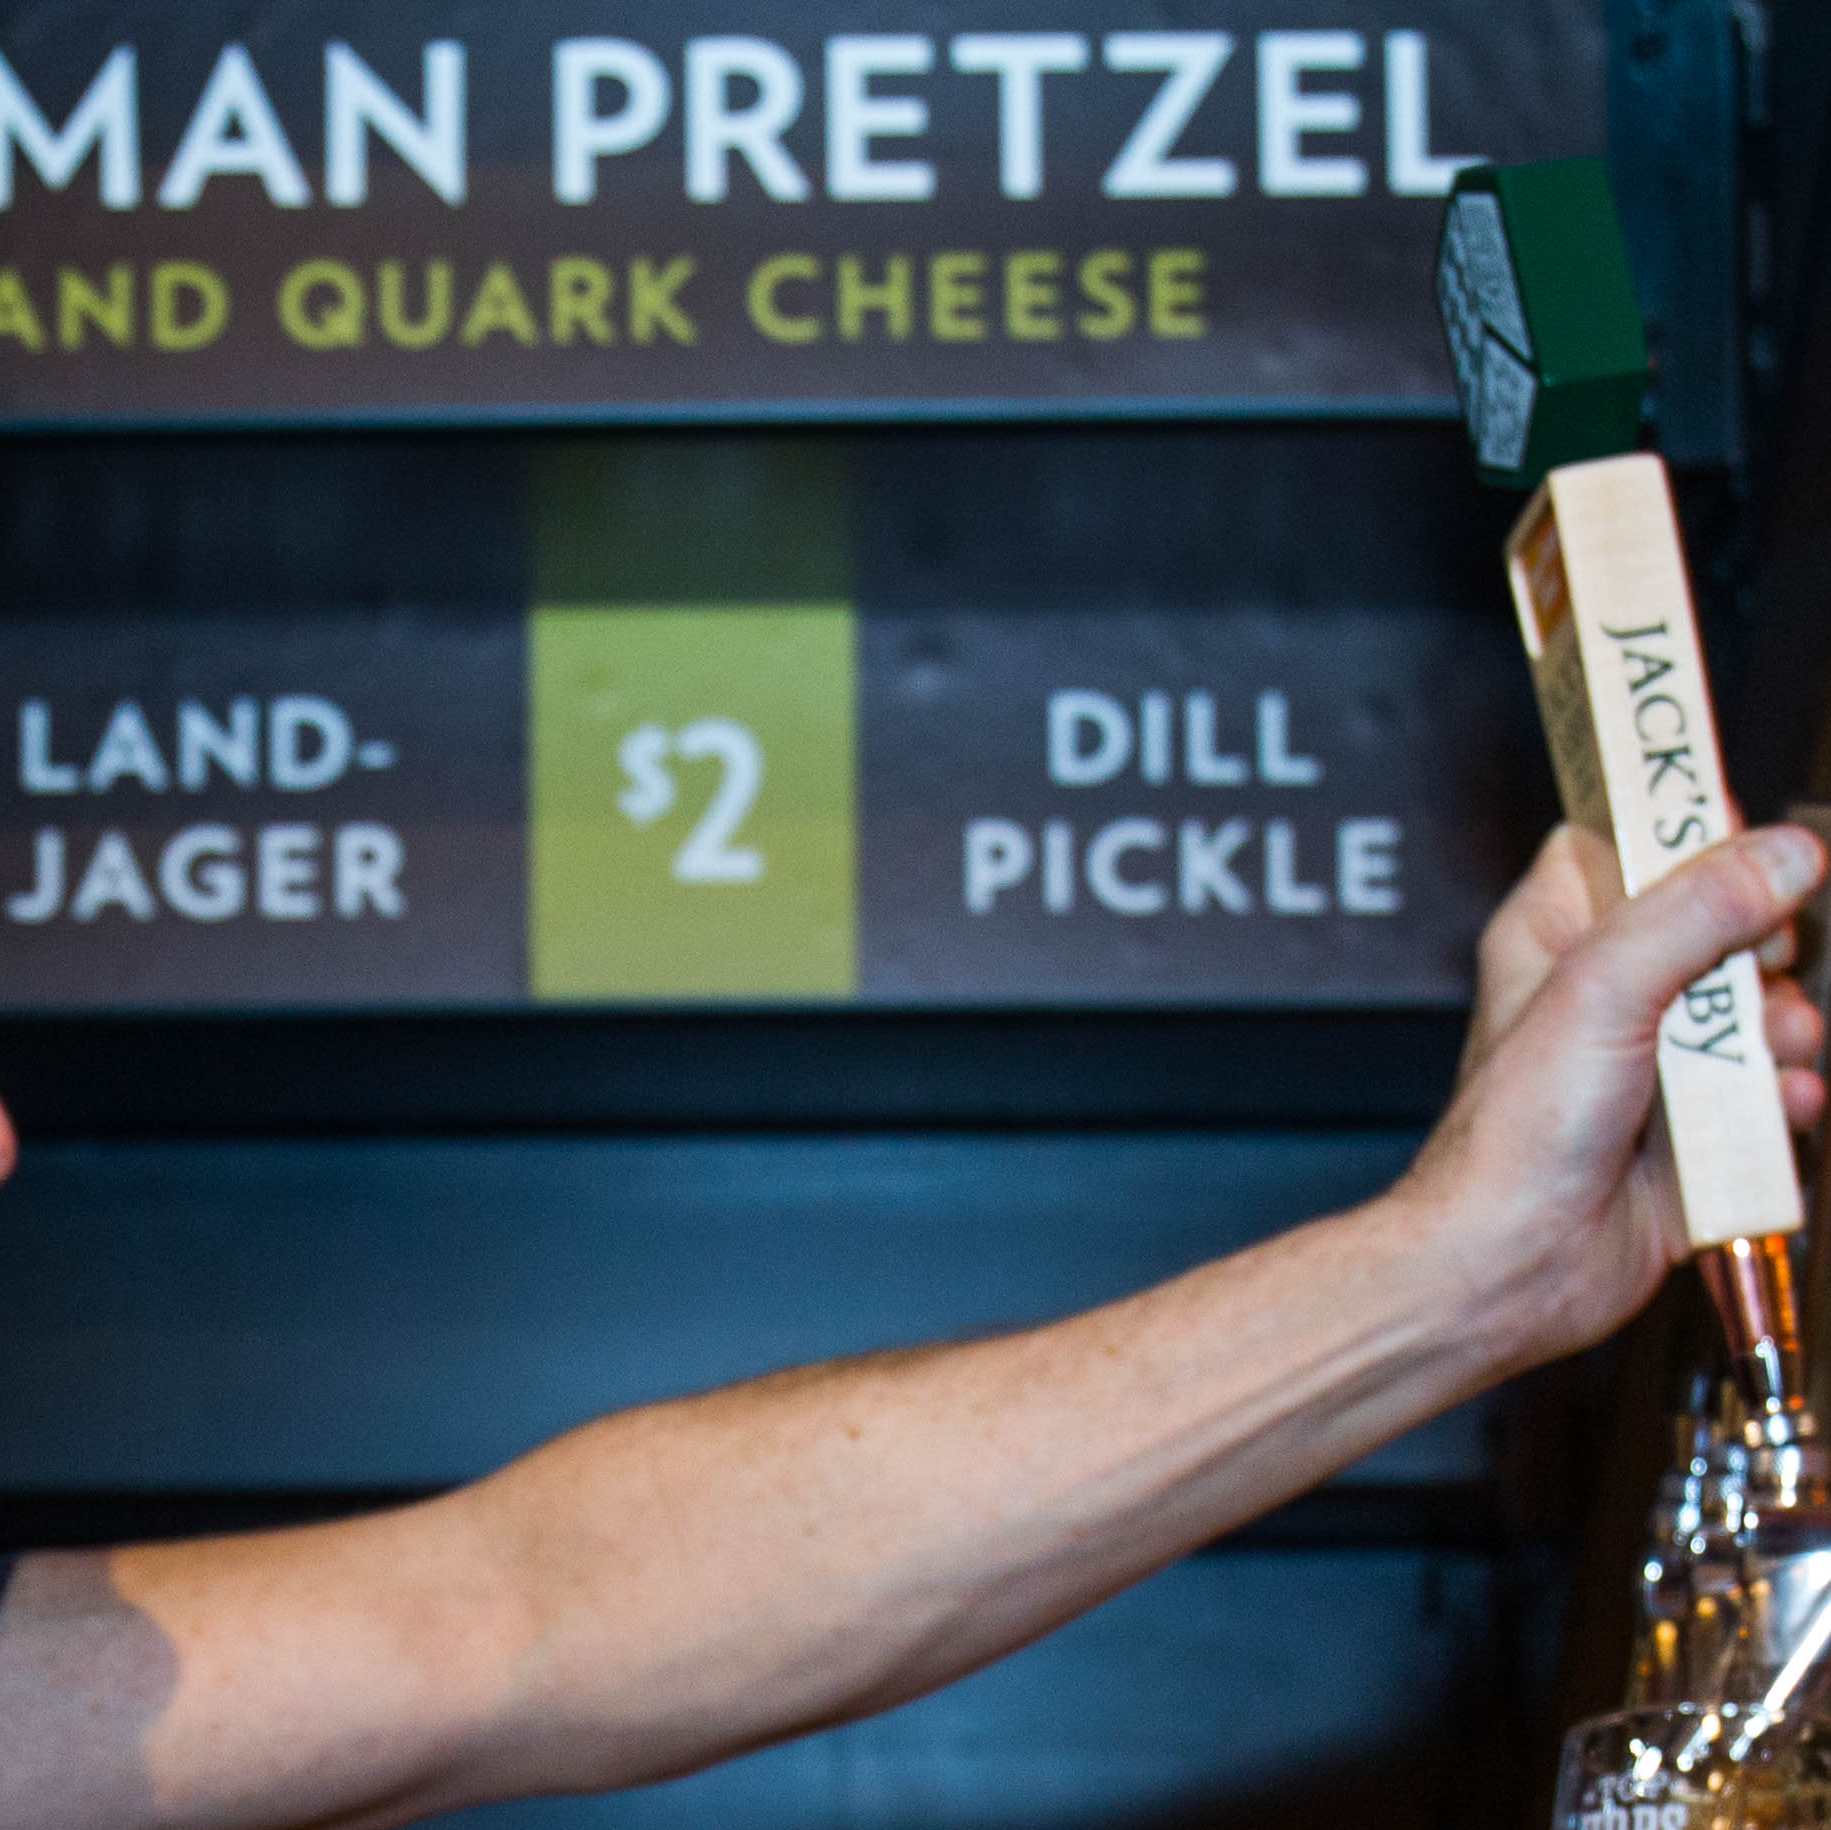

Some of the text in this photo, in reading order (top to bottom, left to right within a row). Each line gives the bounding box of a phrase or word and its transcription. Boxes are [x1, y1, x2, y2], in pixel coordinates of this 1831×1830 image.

[550, 28, 1488, 206] PRETZEL
[274, 254, 702, 353] QUARK
[742, 248, 1208, 347] CHEESE
[18, 694, 396, 796] LAND-
[1043, 686, 1322, 788] DILL
[616, 718, 766, 886] $2
[1602, 617, 1746, 1067] JACK'S BY
[6, 820, 407, 924] JAGER
[960, 814, 1401, 916] PICKLE
